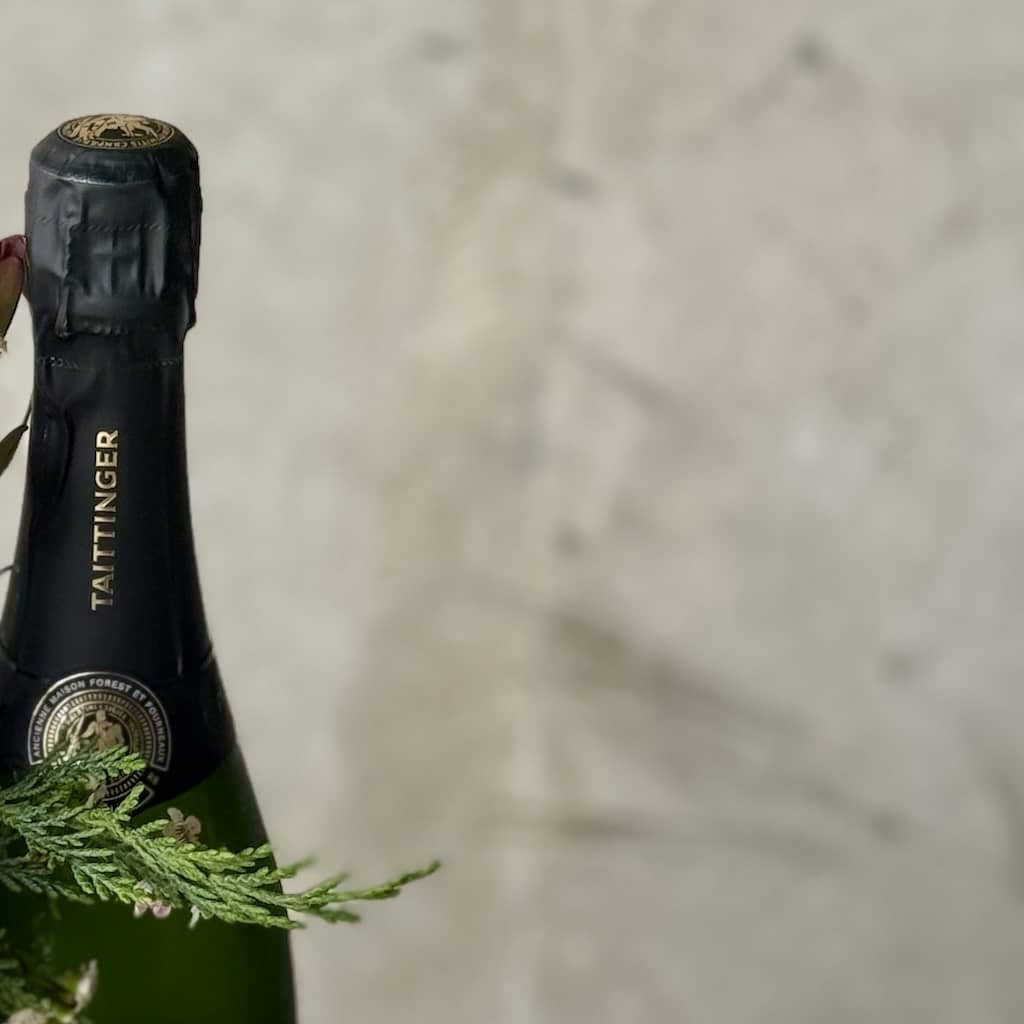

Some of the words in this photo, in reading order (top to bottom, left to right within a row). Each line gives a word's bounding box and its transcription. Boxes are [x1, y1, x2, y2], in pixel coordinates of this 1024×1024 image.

[90, 429, 119, 611] TAITTINGER
[32, 704, 52, 758] ANCIENNE
[49, 680, 86, 705] MAISON
[90, 678, 133, 693] FOREST
[132, 689, 147, 702] ET
